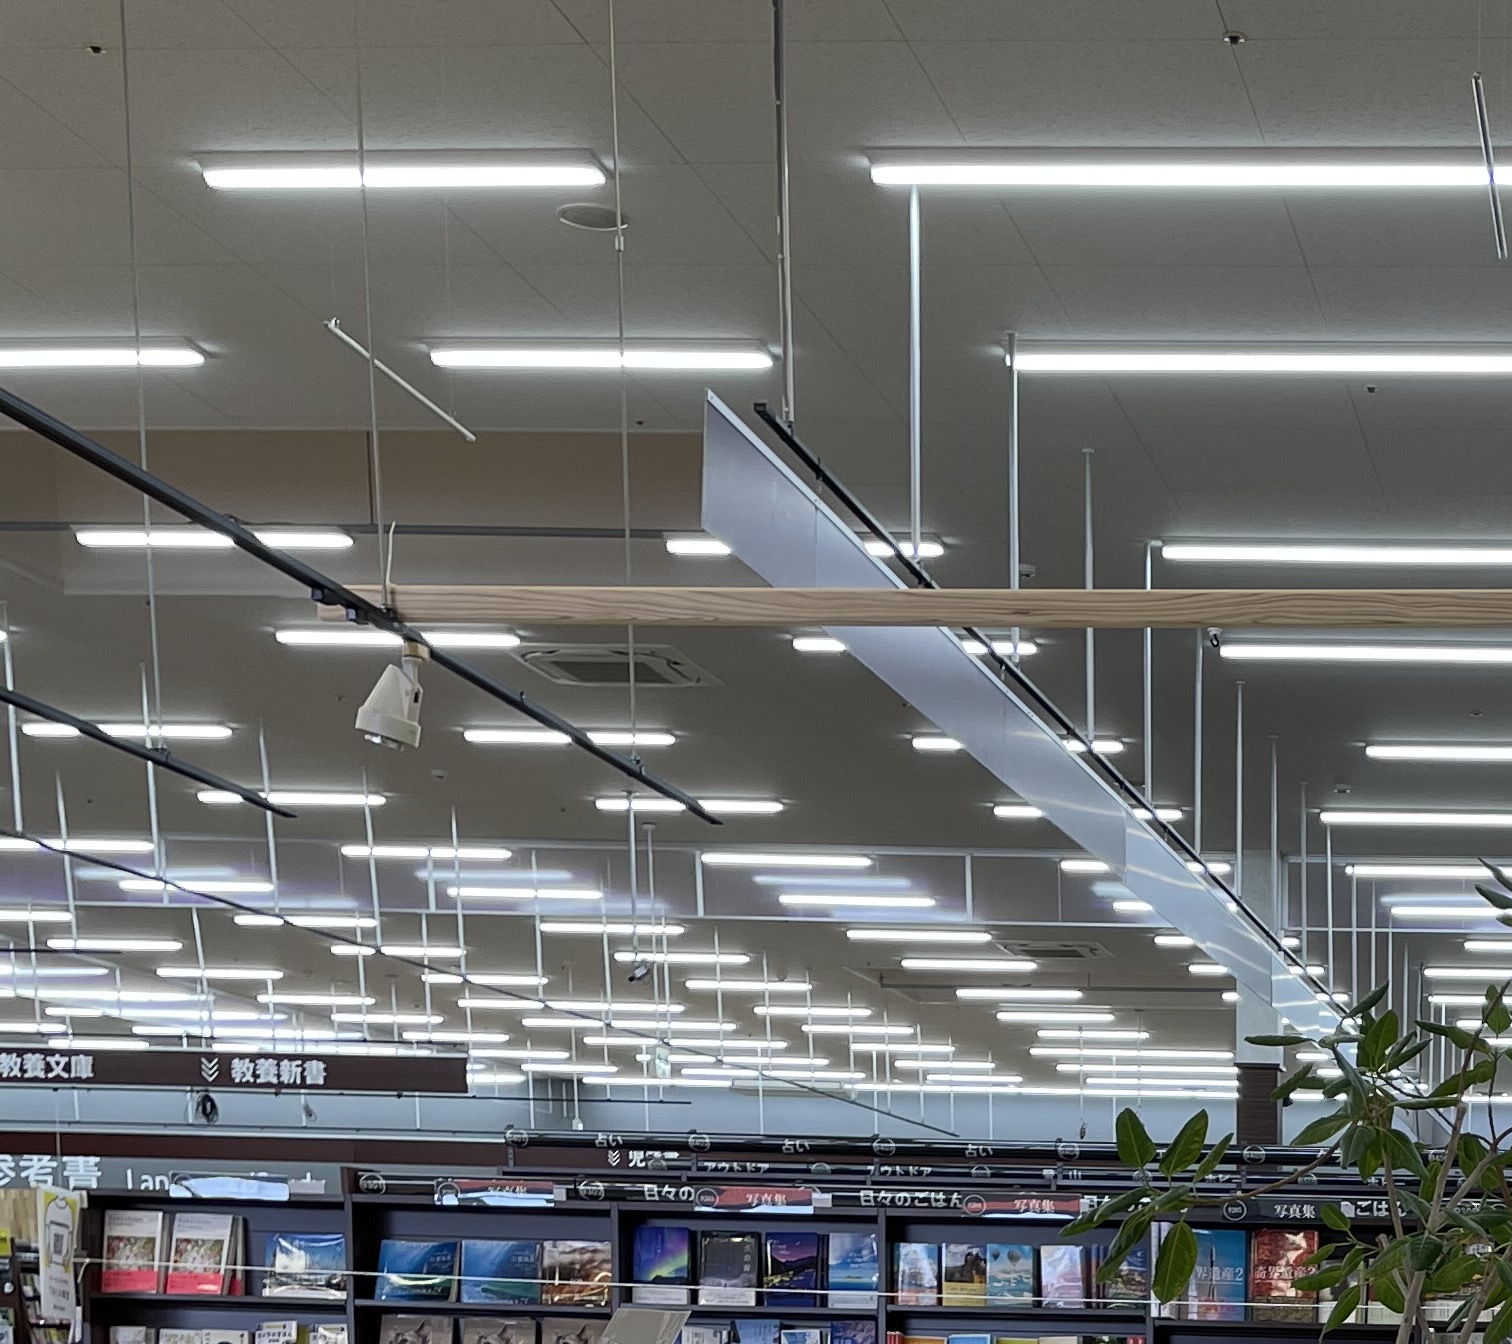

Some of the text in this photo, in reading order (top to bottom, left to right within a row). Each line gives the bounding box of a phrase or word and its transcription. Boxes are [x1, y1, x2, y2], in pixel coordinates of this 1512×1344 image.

[0, 1054, 94, 1079] 教養文庫
[230, 1058, 327, 1085] 教養新書
[1274, 1204, 1316, 1219] 写真集
[1196, 1266, 1244, 1281] 界遺産2
